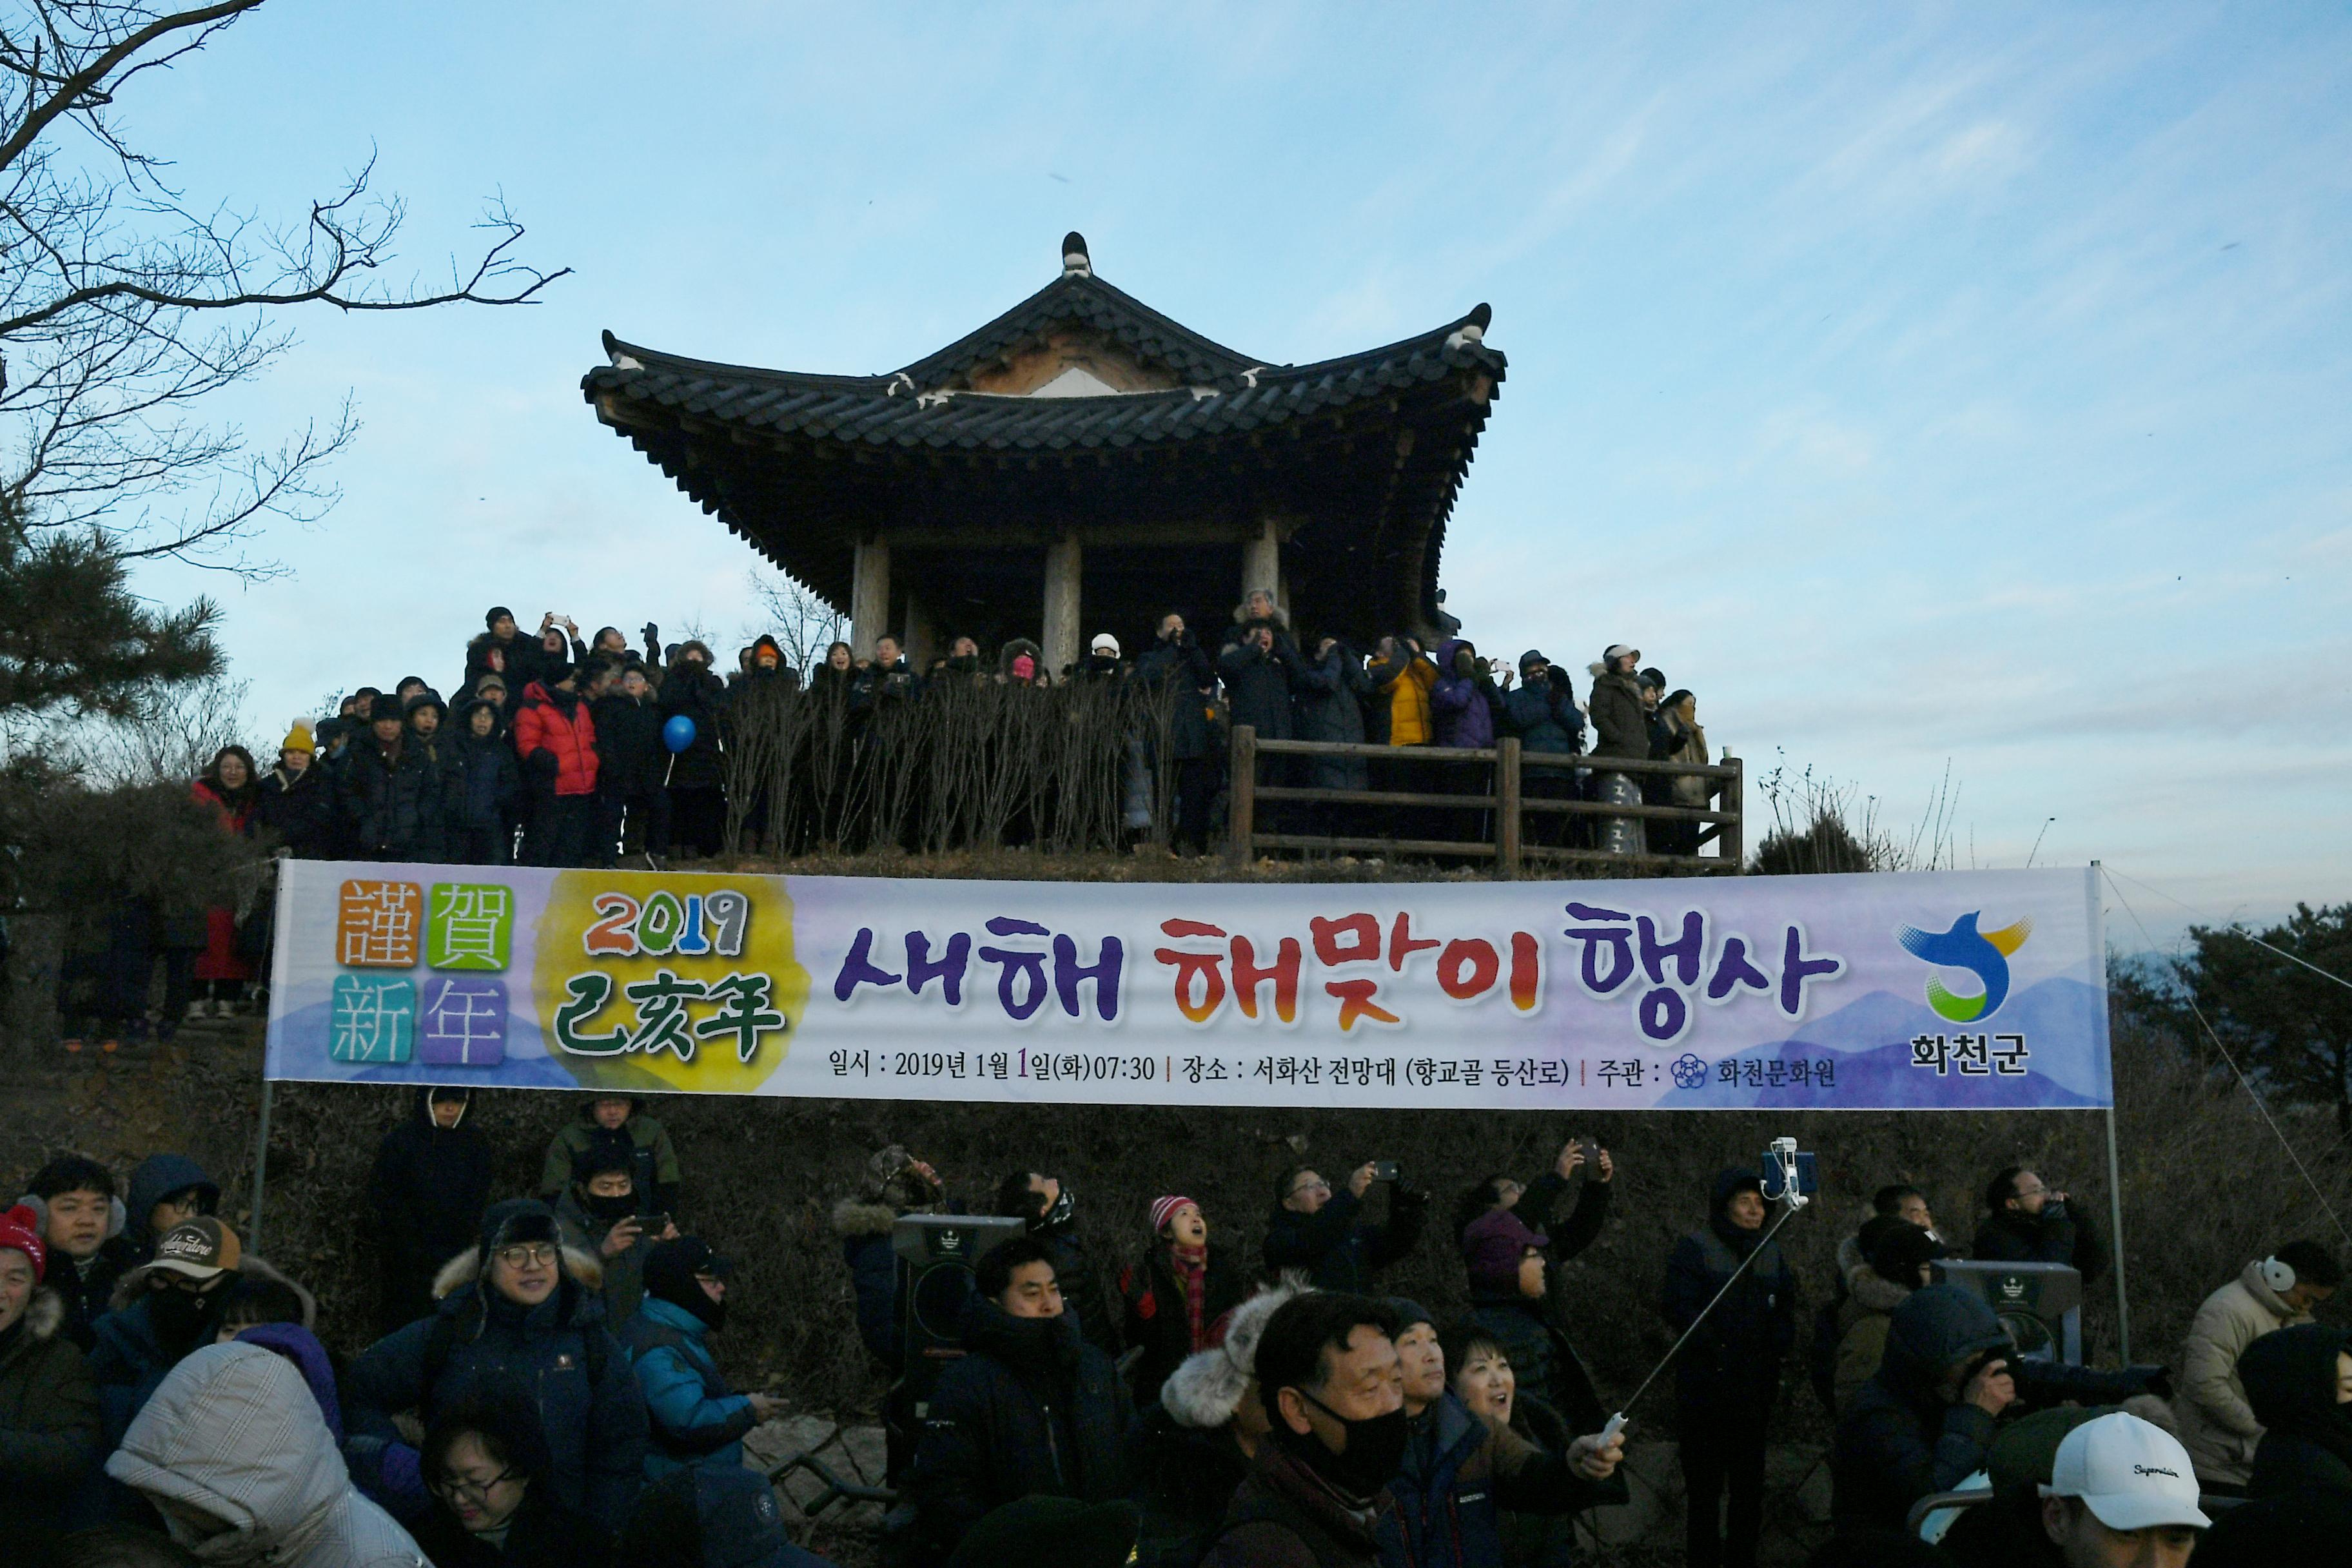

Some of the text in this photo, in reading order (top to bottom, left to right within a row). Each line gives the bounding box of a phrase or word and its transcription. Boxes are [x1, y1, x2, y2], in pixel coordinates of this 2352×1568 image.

[585, 891, 747, 956] 2019
[834, 902, 1840, 1040] 새해 해맞이 행사
[829, 1048, 869, 1078] 일시
[895, 1051, 966, 1079] 2019년
[976, 1052, 1008, 1080] 1월
[1182, 1055, 1228, 1084] 장소
[1253, 1056, 1322, 1086] 서화산
[1329, 1057, 1395, 1086] 전망대
[1406, 1057, 1484, 1087] (향교골
[1491, 1058, 1569, 1088] 등산로)
[1597, 1058, 1645, 1088] 주관
[1718, 1058, 1836, 1088] 화천문화원
[1912, 1035, 2029, 1074] 화천군
